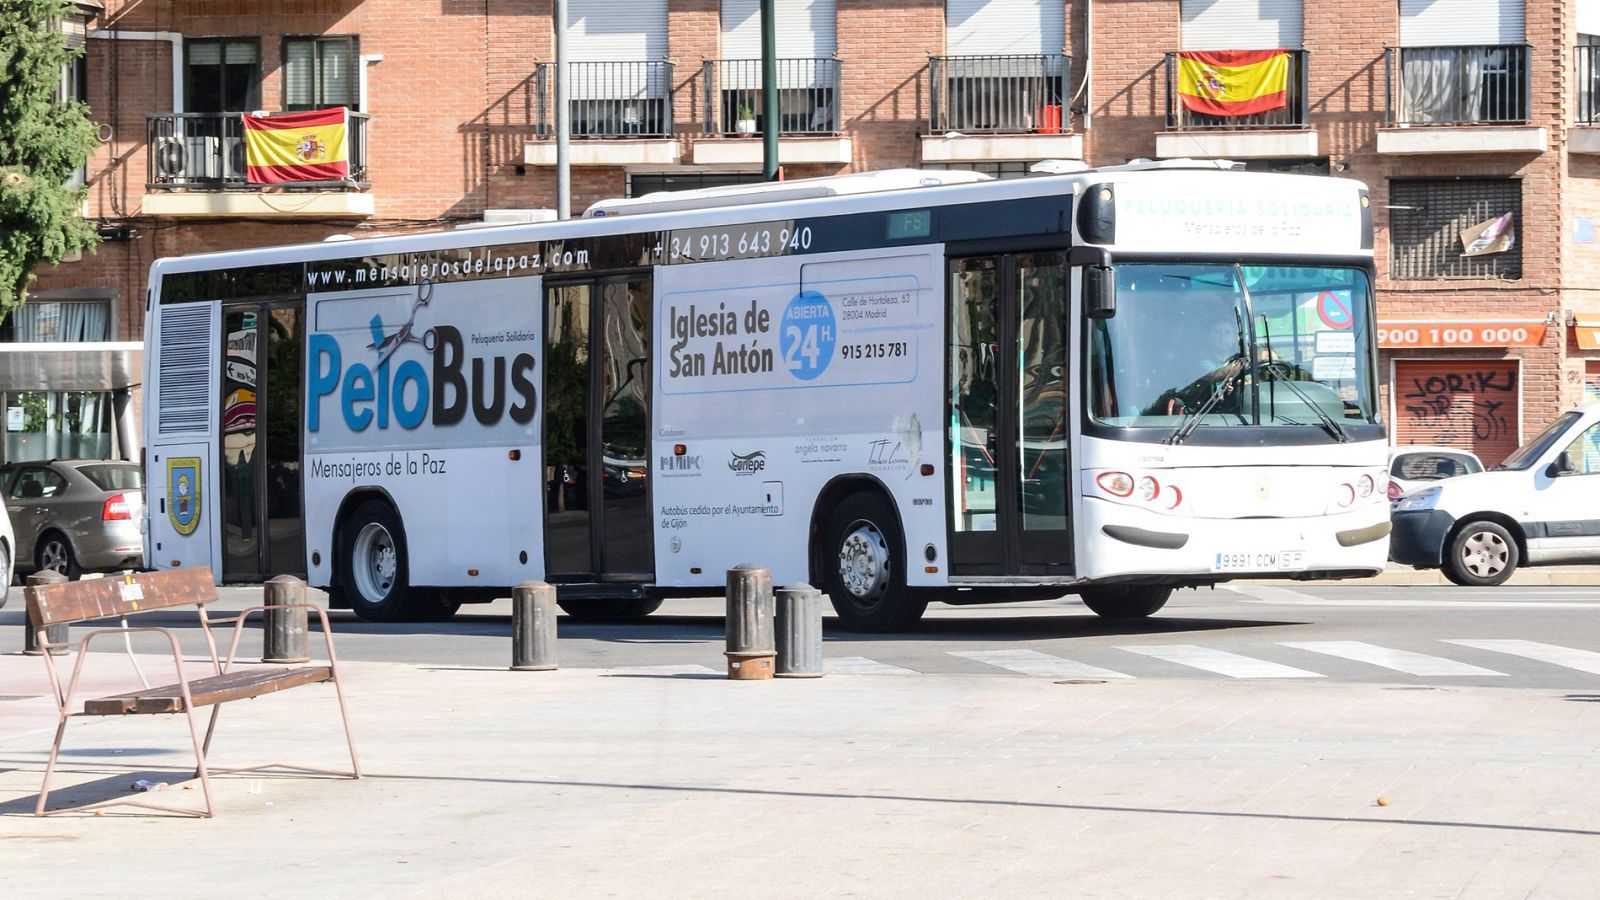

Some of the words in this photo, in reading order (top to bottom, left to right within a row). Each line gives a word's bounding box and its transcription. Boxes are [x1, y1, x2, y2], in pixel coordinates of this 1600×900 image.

[671, 235, 692, 259] 34
[700, 233, 730, 257] 913
[738, 229, 771, 254] 643
[779, 226, 812, 251] 940
[307, 249, 589, 285] www.mensajerosdelapaz.com
[842, 296, 858, 307] Calle
[859, 296, 867, 306] de
[786, 304, 830, 320] ABIERTA
[842, 310, 863, 320] 28004
[864, 309, 887, 320] Madrid
[670, 303, 737, 344] Iglesia
[744, 300, 770, 335] de
[1377, 329, 1419, 344] 900
[1430, 328, 1473, 343] 100
[1481, 327, 1528, 343] 000
[784, 323, 820, 370] 24
[841, 344, 862, 359] 915
[865, 343, 885, 358] 215
[888, 342, 907, 357] 781
[669, 342, 705, 378] San
[712, 340, 774, 376] Antón
[311, 457, 382, 483] Mensajeros
[385, 453, 402, 476] de
[406, 452, 418, 475] la
[422, 453, 446, 475] Paz
[661, 505, 688, 516] Autobús
[689, 503, 711, 515] cedido
[712, 505, 724, 517] por
[725, 503, 732, 515] el
[732, 503, 779, 517] Ayuntamiento
[661, 518, 670, 529] de
[670, 518, 688, 531] Gijón
[1222, 553, 1251, 568] 9991
[1256, 552, 1277, 568] CCM
